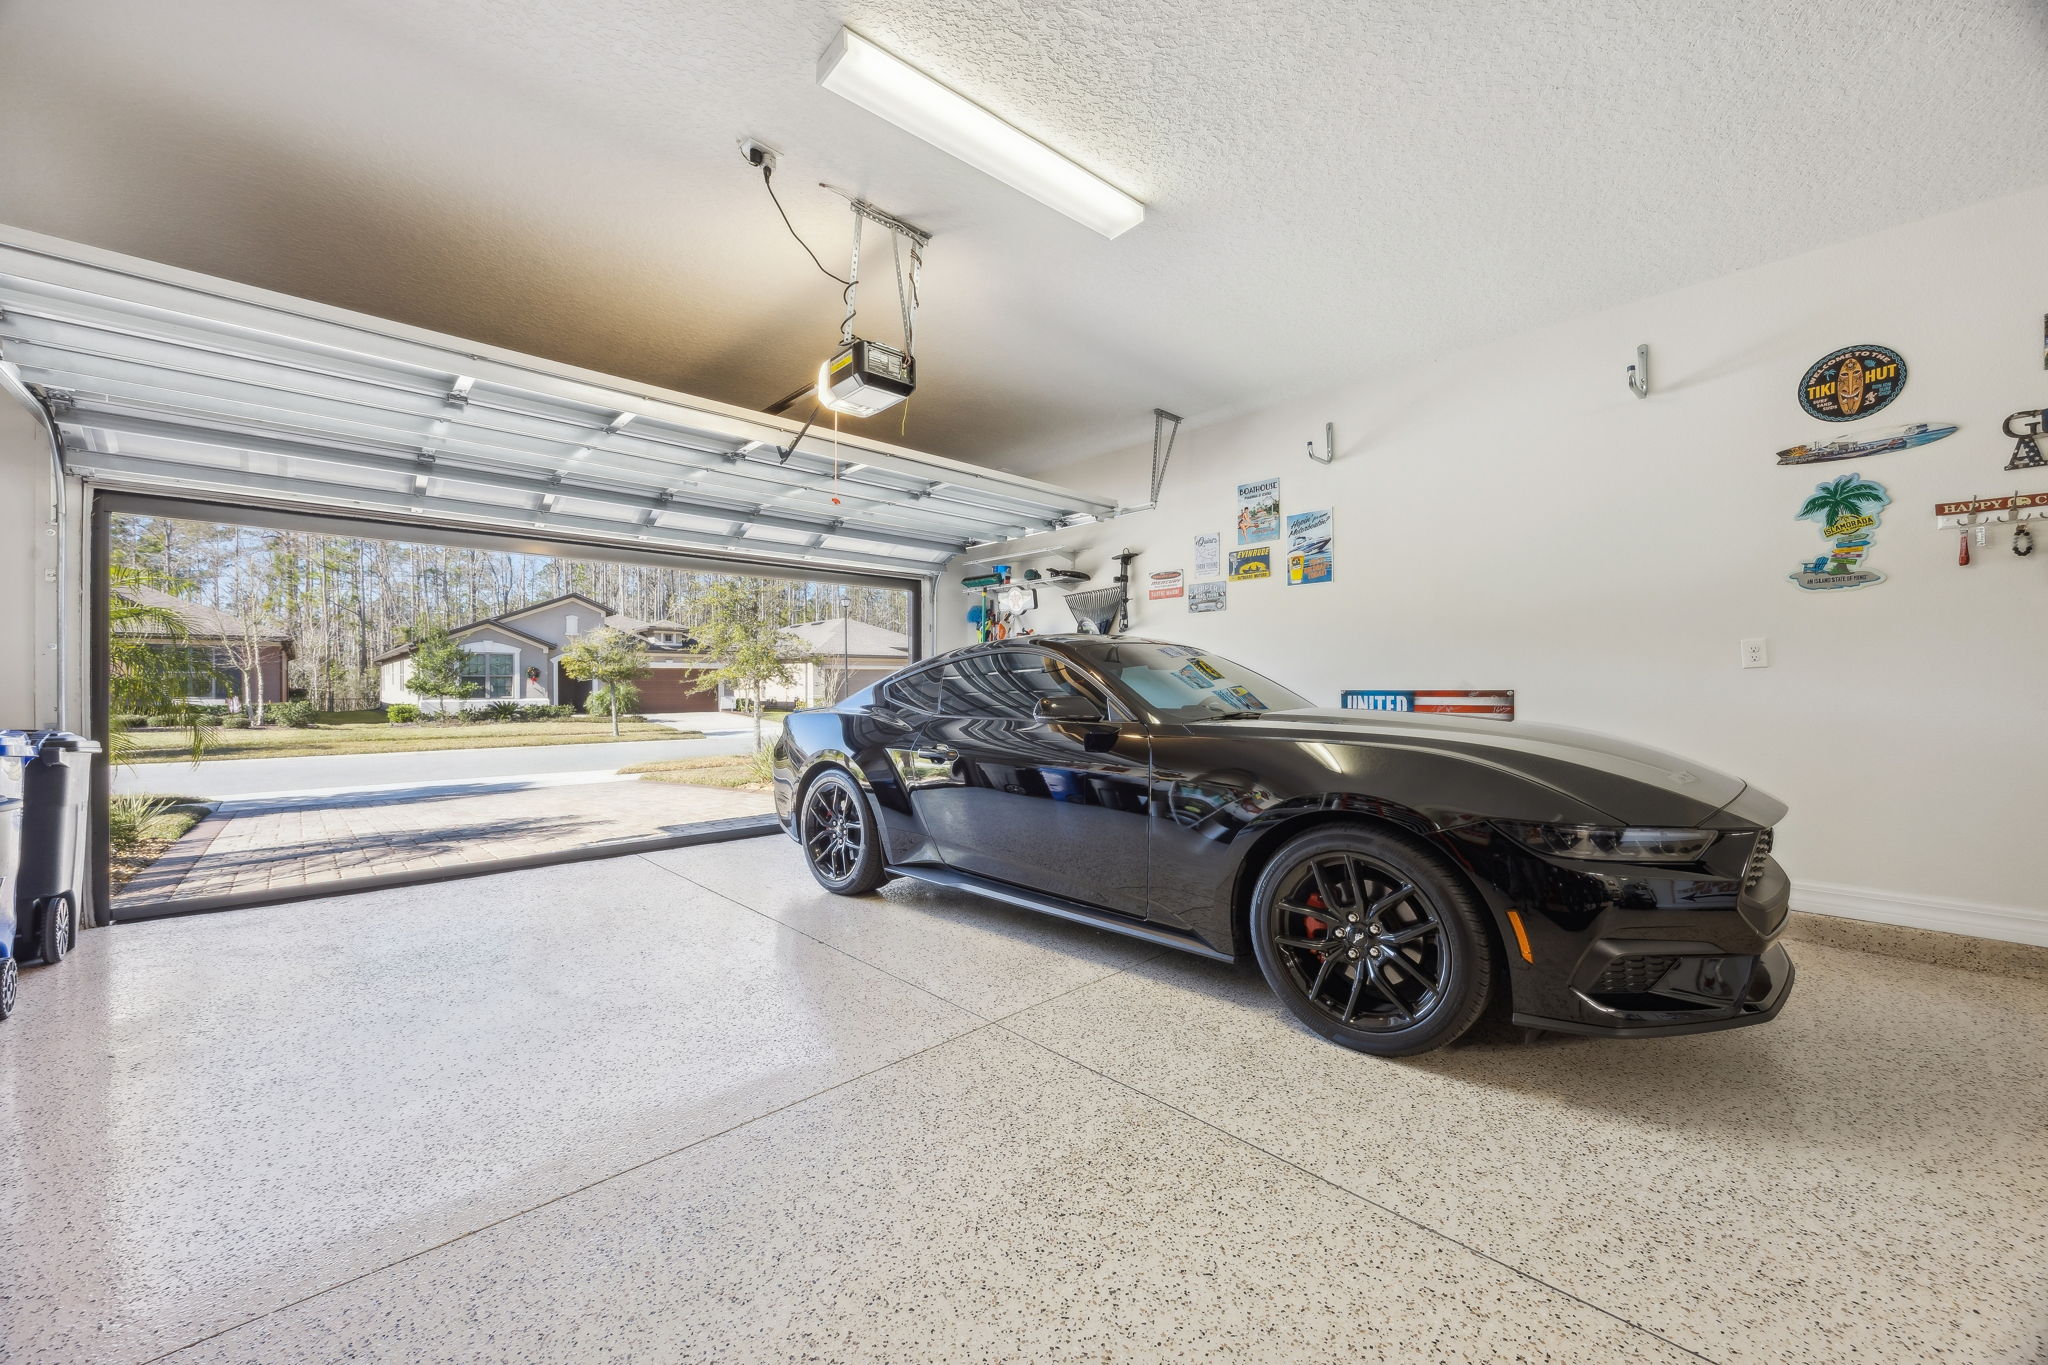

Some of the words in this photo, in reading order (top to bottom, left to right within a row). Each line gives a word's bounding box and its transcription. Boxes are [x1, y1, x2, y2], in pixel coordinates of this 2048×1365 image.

[1809, 353, 1853, 385] WELCOME
[1871, 352, 1891, 363] THE
[1807, 382, 1836, 400] TIKI
[1865, 364, 1898, 384] HUT
[1239, 481, 1278, 496] BOATHOUSE
[1943, 499, 2003, 514] HAPPY
[1824, 517, 1874, 536] ISLAMORADA
[1237, 547, 1270, 559] EVINRUDE
[1347, 695, 1408, 712] UNITED
